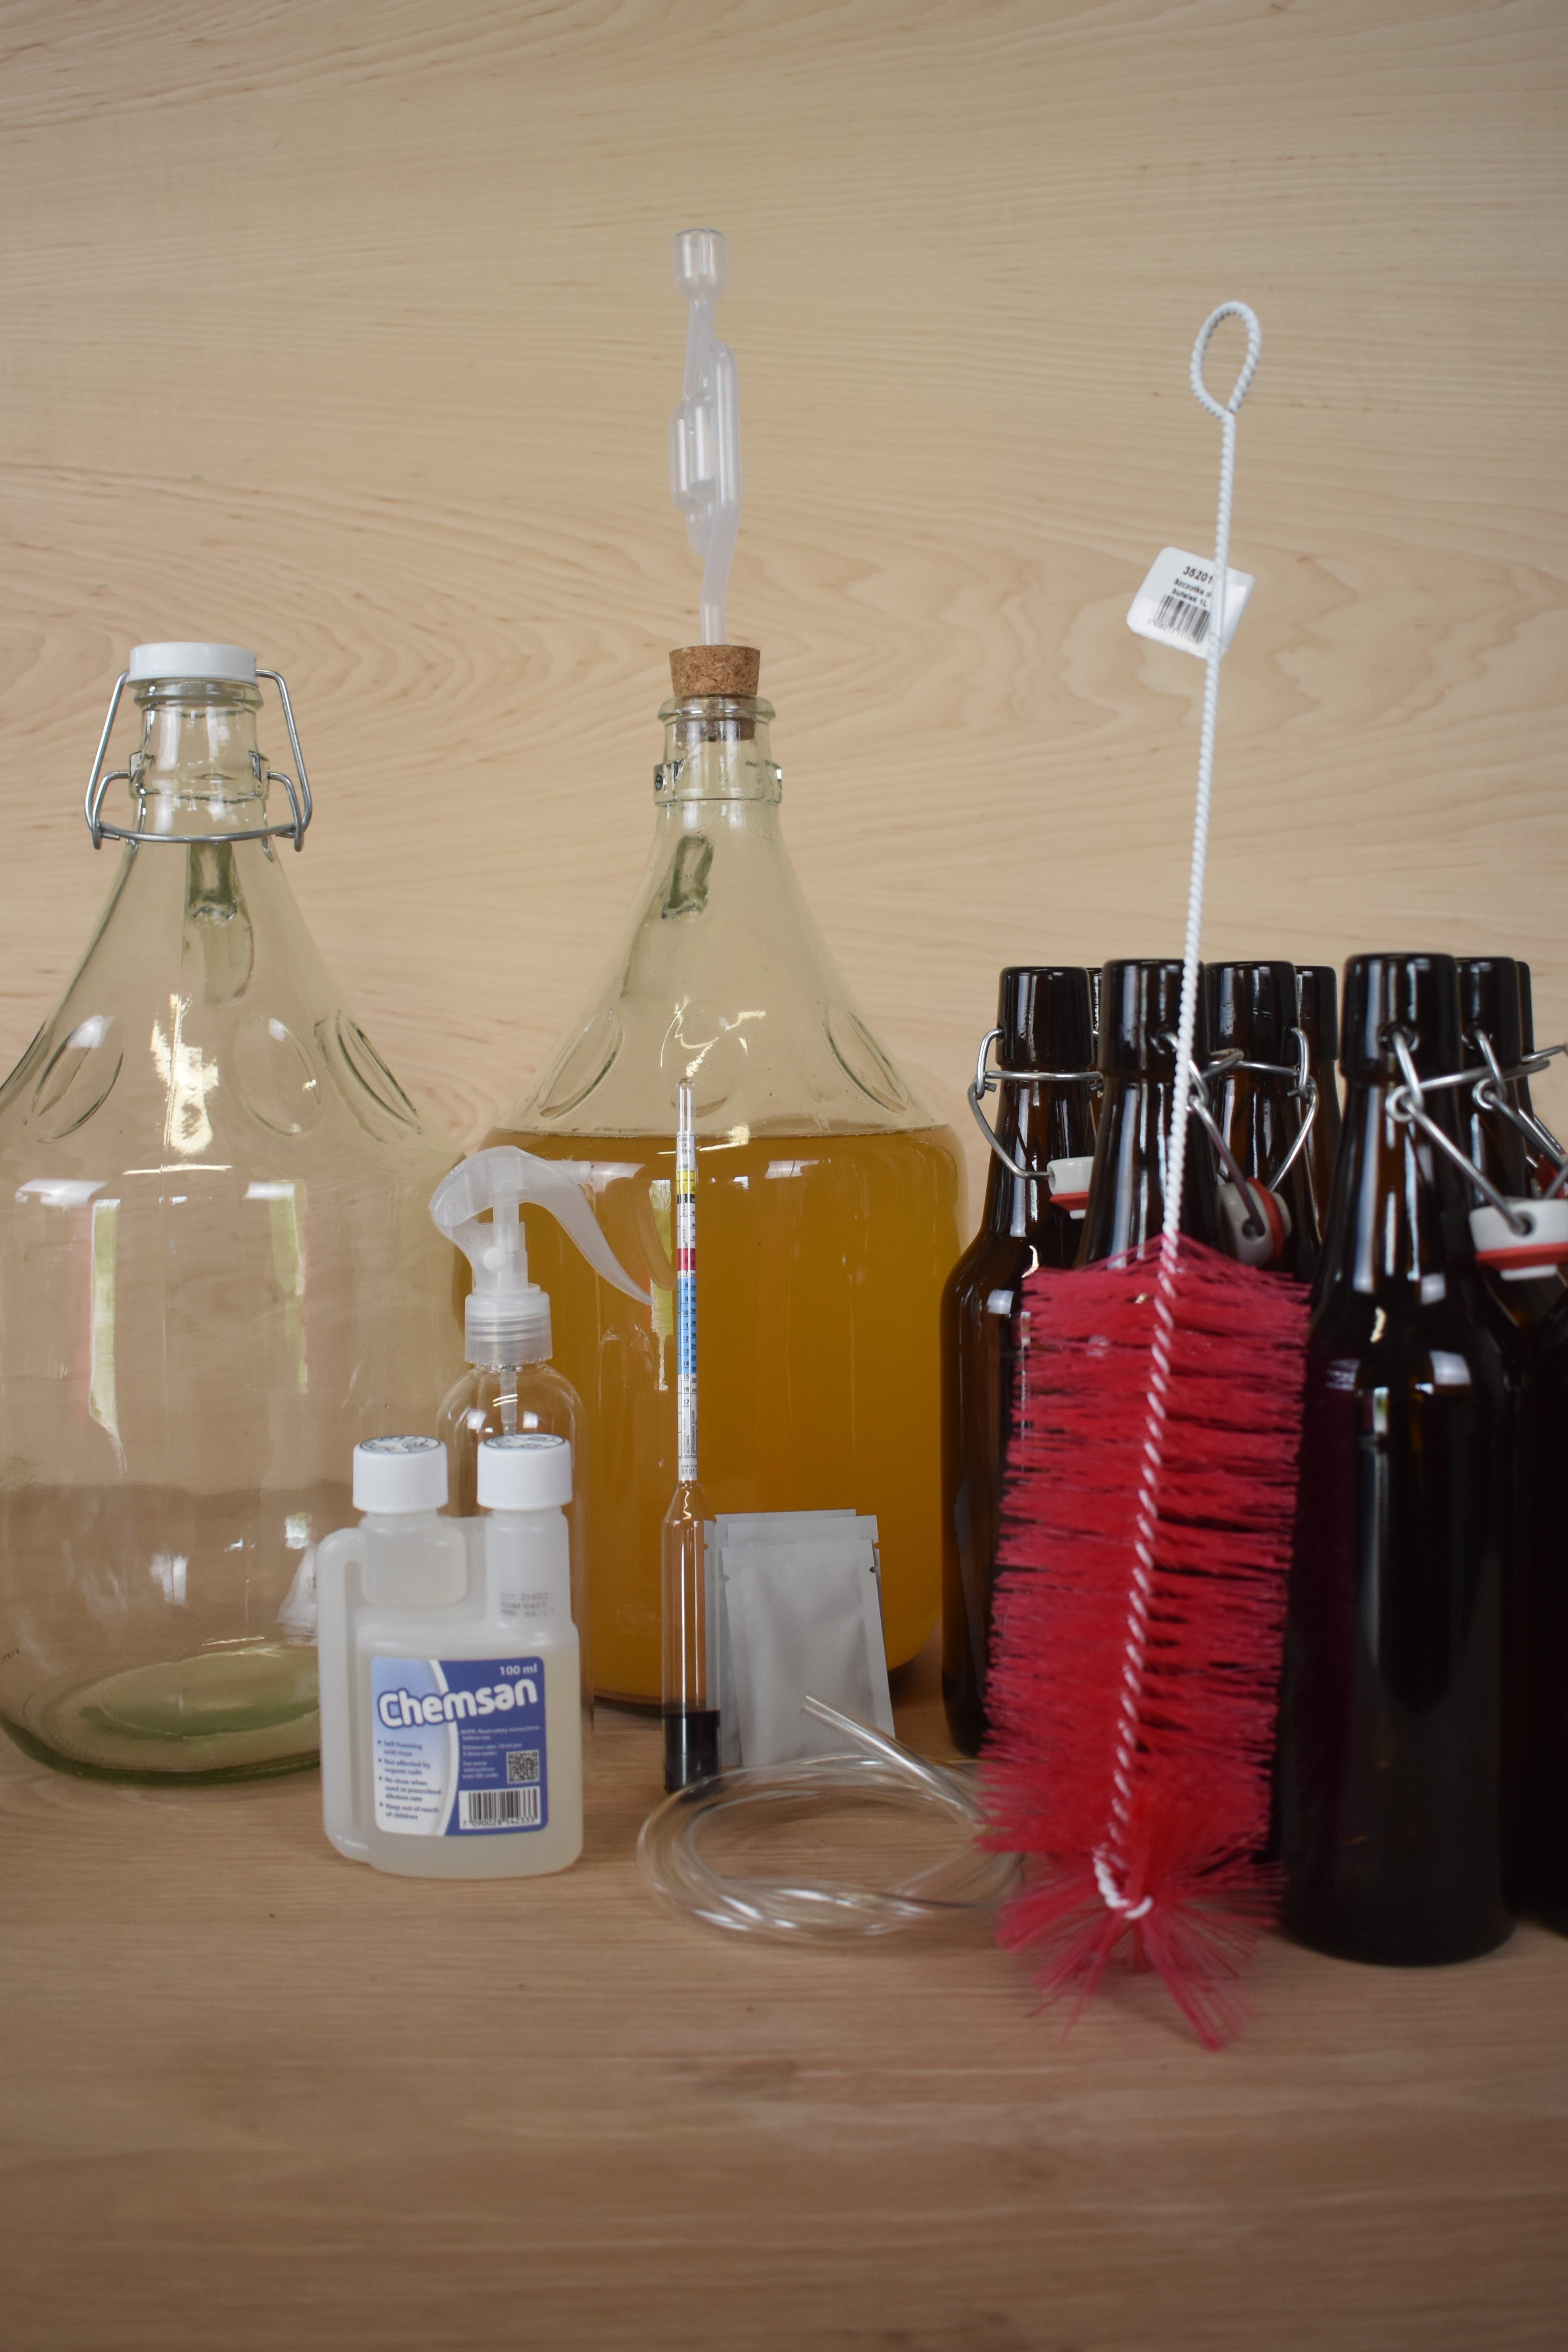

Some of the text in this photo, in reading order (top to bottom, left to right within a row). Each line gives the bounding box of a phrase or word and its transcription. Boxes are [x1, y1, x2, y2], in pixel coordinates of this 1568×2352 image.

[1183, 566, 1213, 584] 35201
[500, 1663, 538, 1675] 100 ml
[378, 1678, 538, 1727] Chemsan
